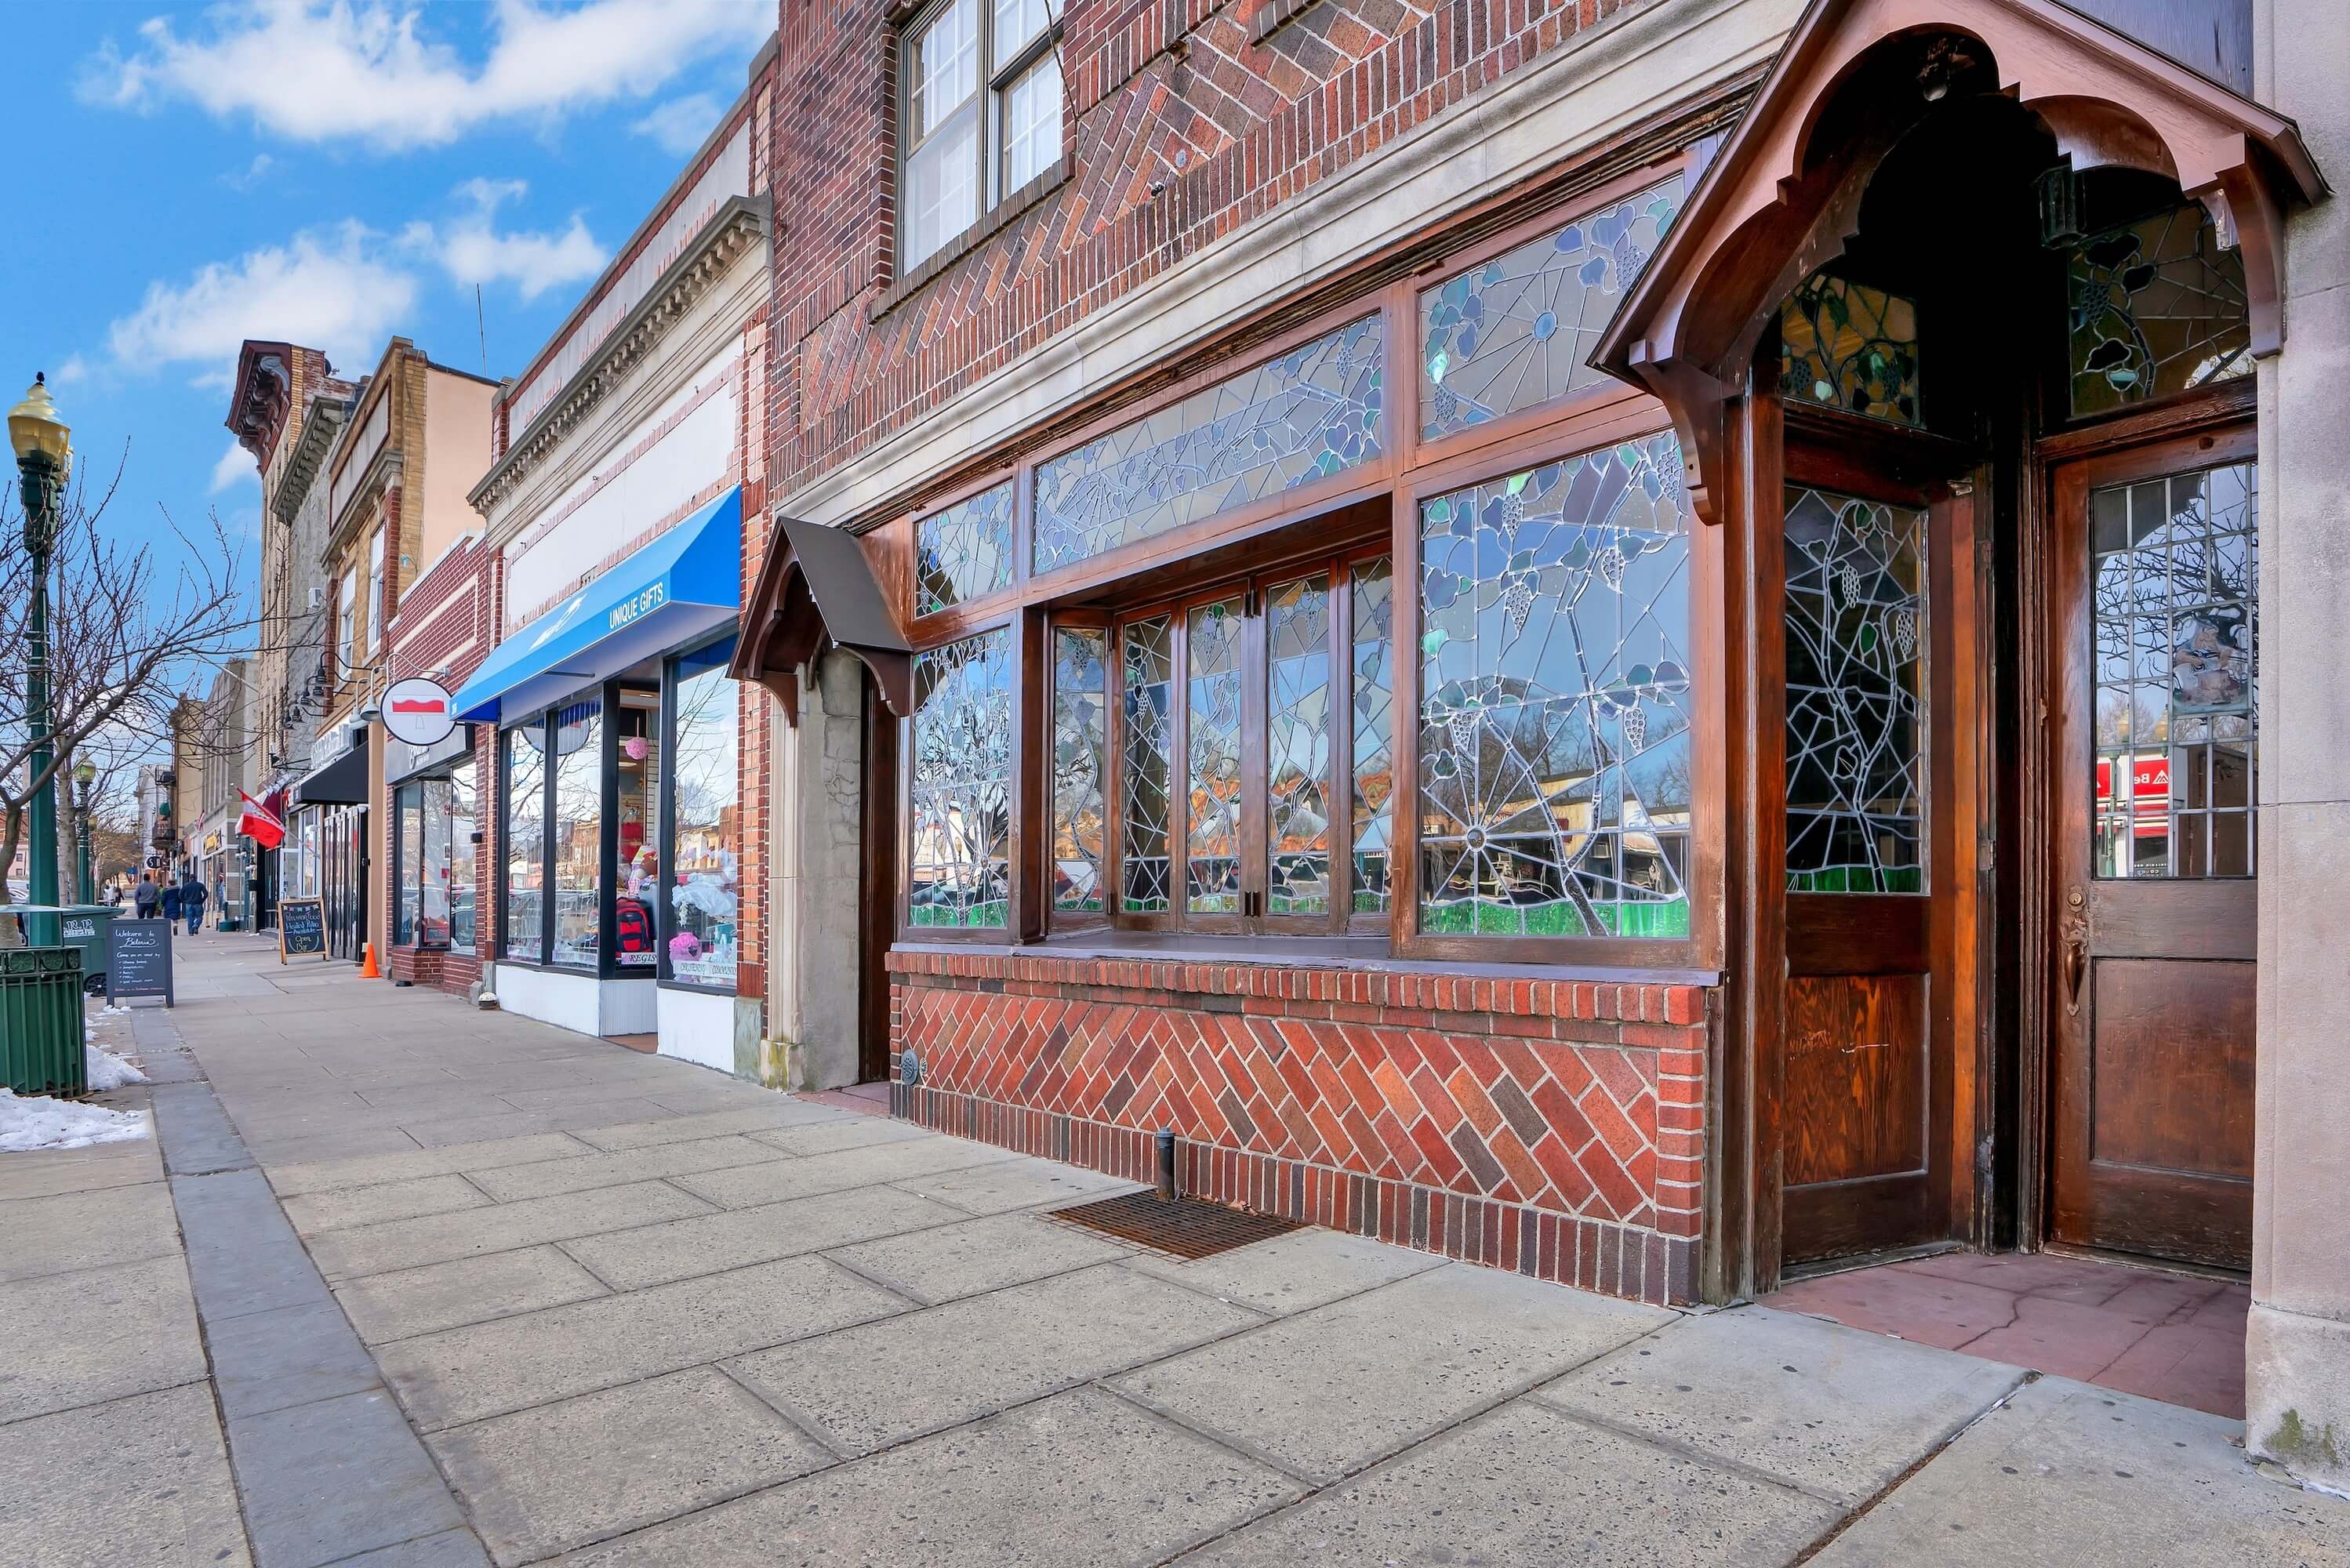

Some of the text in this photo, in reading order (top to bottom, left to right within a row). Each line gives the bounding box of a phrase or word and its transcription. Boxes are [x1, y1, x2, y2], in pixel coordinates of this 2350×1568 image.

[609, 597, 638, 629] UNIQUE
[640, 582, 663, 612] GIFTS
[295, 935, 311, 945] Open
